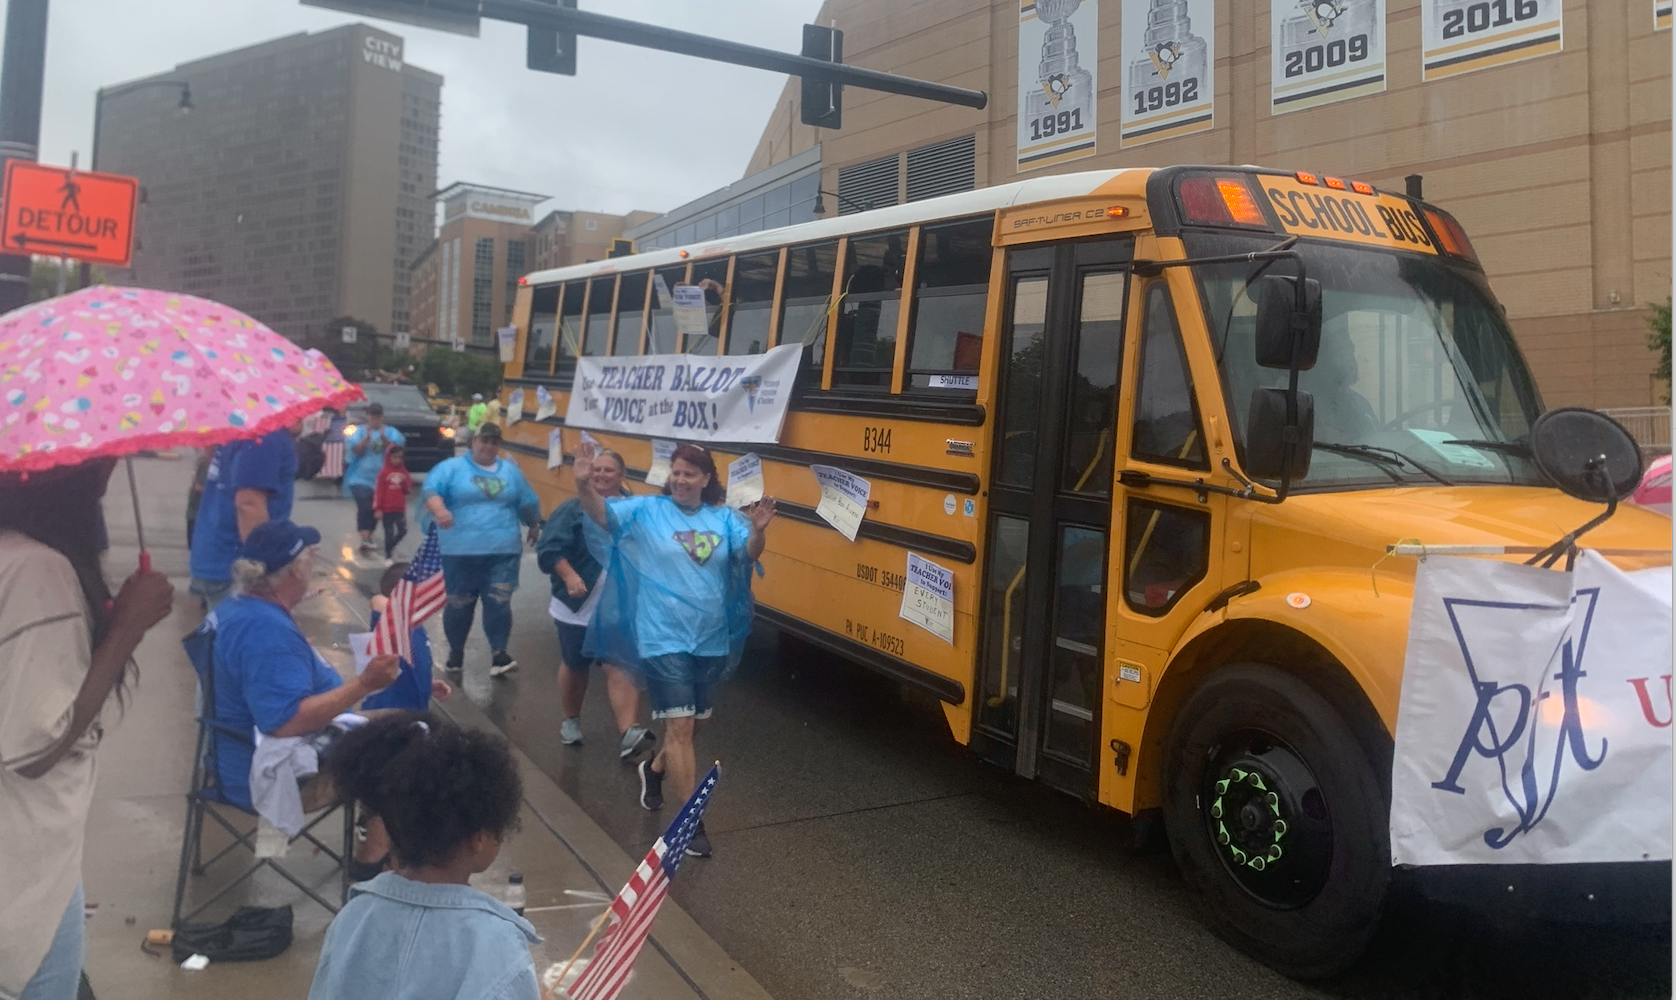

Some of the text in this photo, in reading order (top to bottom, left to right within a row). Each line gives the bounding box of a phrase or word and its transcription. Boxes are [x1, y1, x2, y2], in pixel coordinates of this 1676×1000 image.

[1443, 0, 1538, 40] 2016
[365, 36, 399, 57] CITY
[1285, 34, 1368, 78] 2009
[363, 48, 401, 73] VIEW
[1134, 77, 1198, 115] 1992
[1030, 107, 1084, 141] 1991
[18, 207, 118, 239] DETOUR
[1085, 209, 1104, 218] C2
[1268, 188, 1431, 247] SCHOOL BUS
[598, 365, 665, 391] TEACHER
[670, 364, 746, 394] BALLOT
[940, 375, 970, 386] SHUTTLE
[603, 397, 646, 424] VOICE
[649, 402, 657, 417] at
[660, 398, 673, 415] the
[672, 400, 718, 431] BOX!
[863, 427, 891, 454] B344
[818, 472, 868, 498] TEACHER VOICE
[838, 471, 847, 479] Use
[848, 475, 855, 483] My
[856, 563, 878, 583] USDOT
[911, 564, 938, 584] TEACHER
[928, 565, 937, 574] Use
[937, 570, 945, 579] My
[914, 586, 939, 606] EVERY
[927, 582, 947, 597] Support:
[916, 599, 948, 619] STUDENT
[845, 618, 904, 656] PA PUC A-109523
